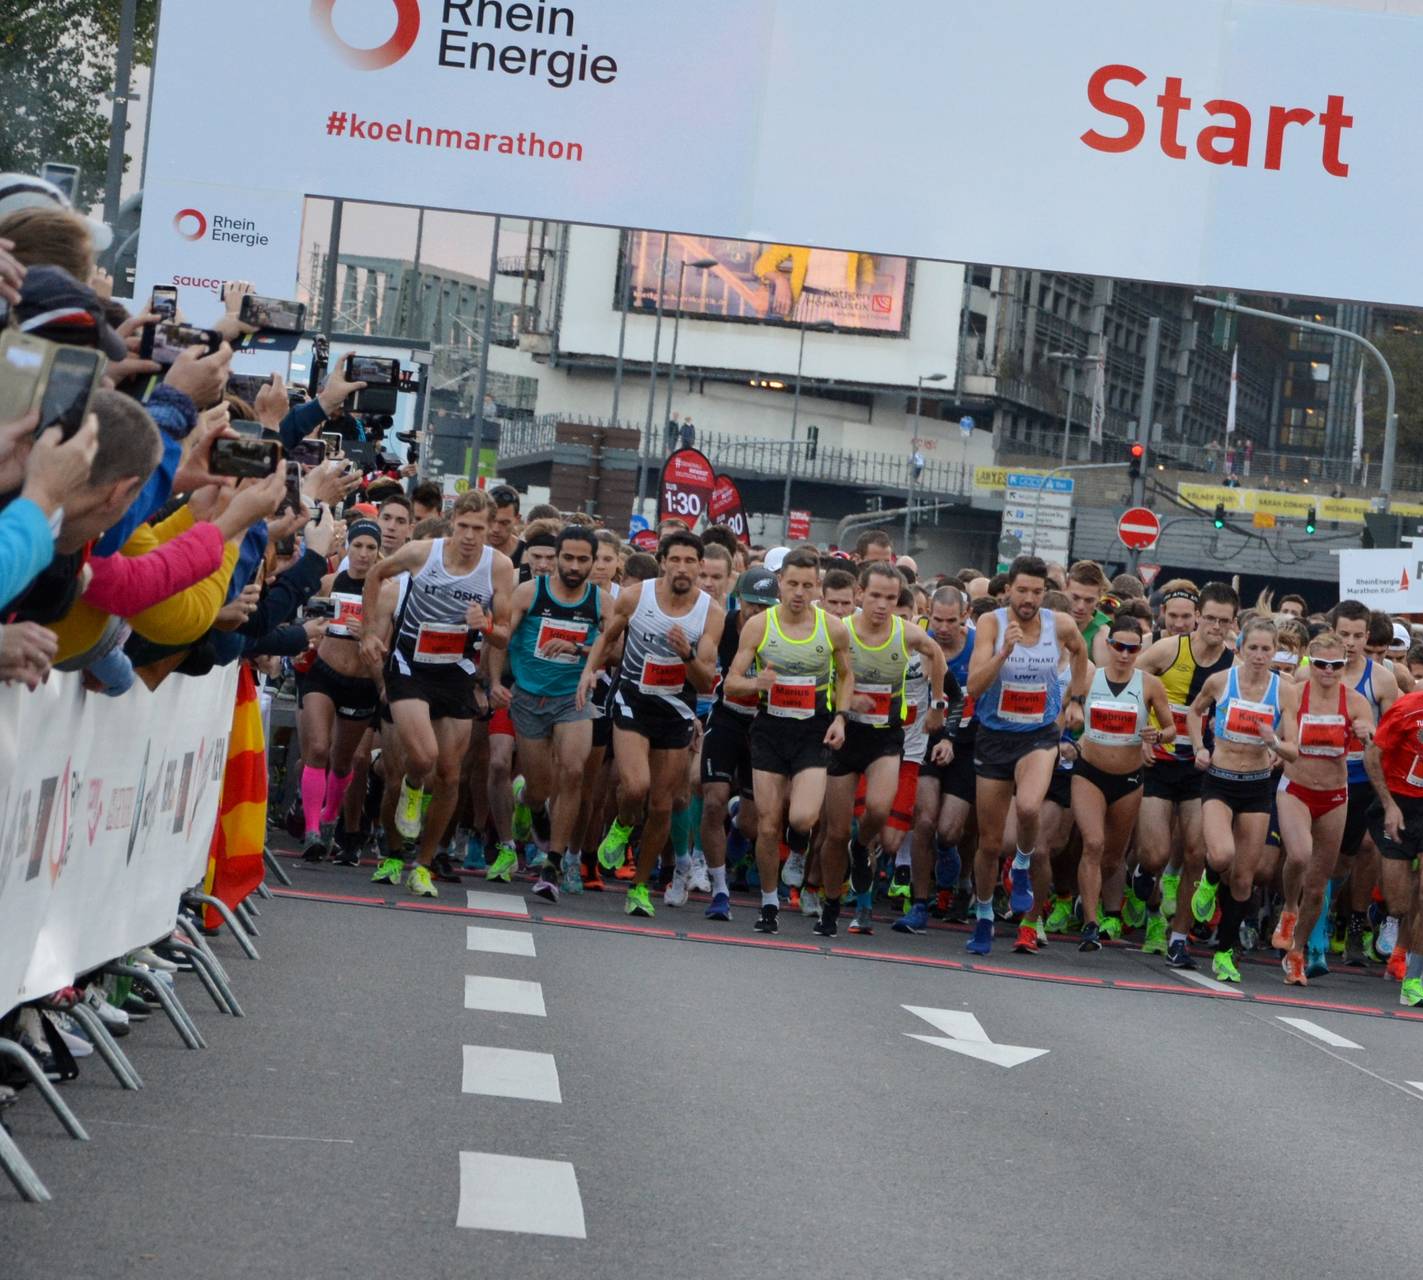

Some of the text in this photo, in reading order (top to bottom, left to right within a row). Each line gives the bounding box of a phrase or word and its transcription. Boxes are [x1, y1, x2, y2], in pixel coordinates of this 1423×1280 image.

[442, 0, 575, 37] Rhein
[438, 29, 618, 89] Energie
[326, 110, 584, 161] #koelnmarathon
[1080, 64, 1353, 178] Start
[212, 229, 269, 247] Energie
[213, 215, 255, 231] Rhein
[665, 490, 701, 516] 1:30
[424, 584, 438, 596] LT
